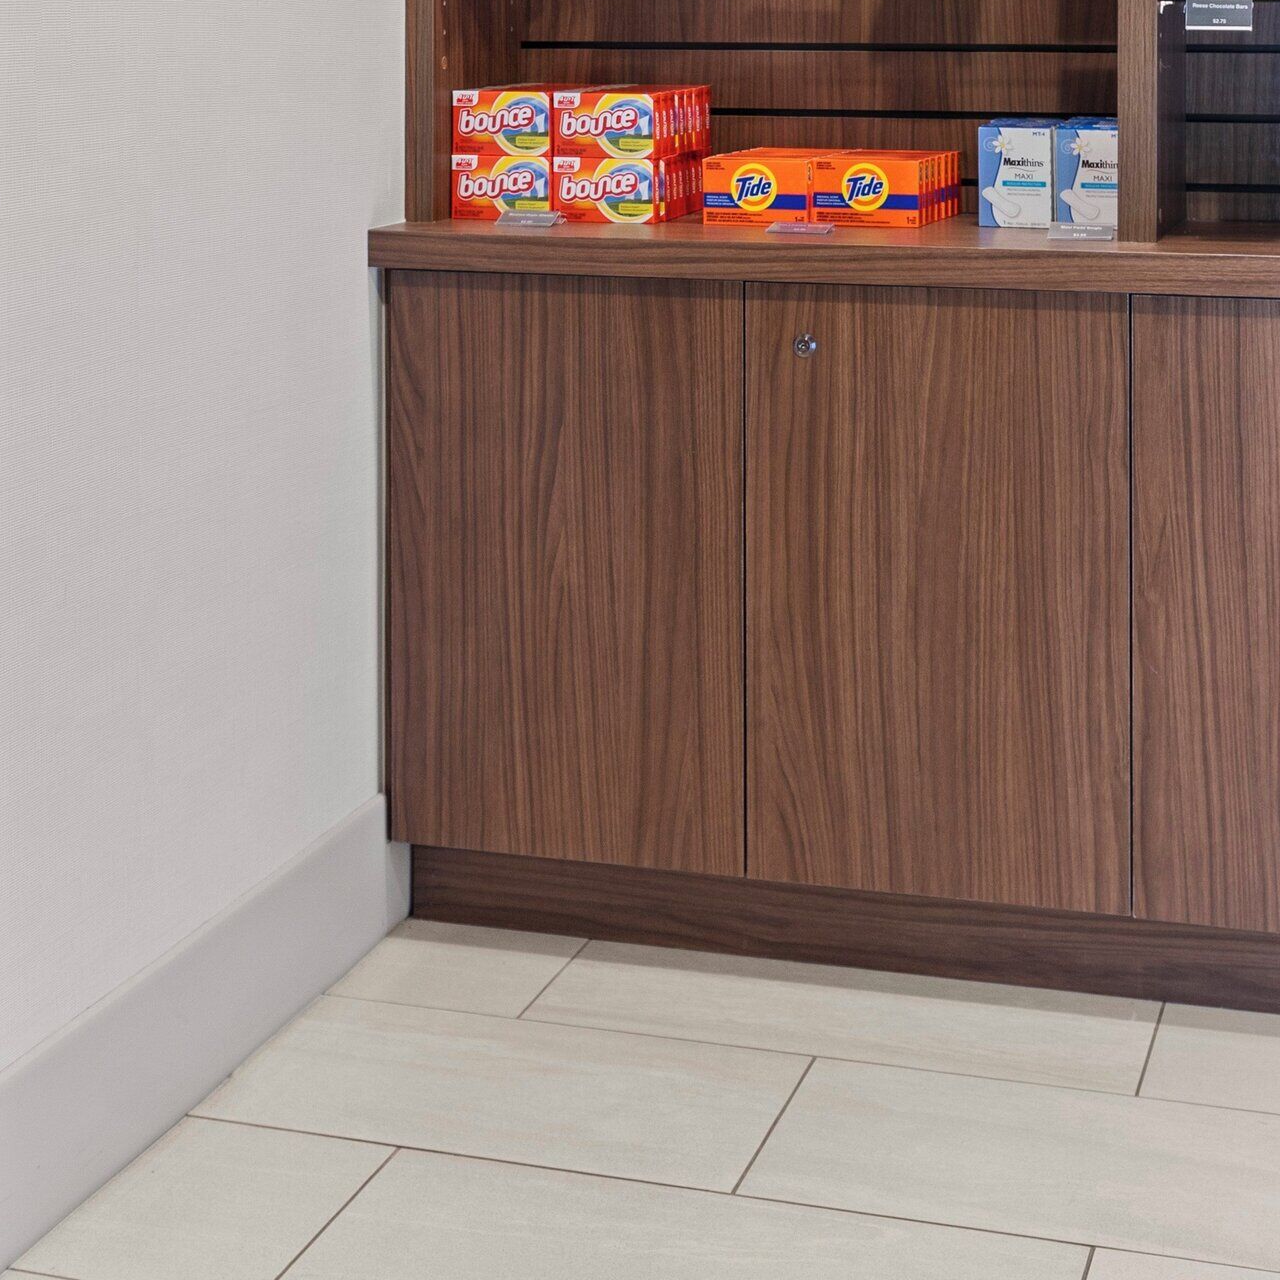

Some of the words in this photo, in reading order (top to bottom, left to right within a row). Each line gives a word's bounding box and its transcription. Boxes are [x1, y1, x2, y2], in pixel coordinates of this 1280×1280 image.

[459, 105, 536, 137] bounce
[560, 106, 639, 138] bounce
[1003, 156, 1045, 168] Maxithins
[458, 169, 536, 202] bounce
[559, 171, 638, 203] bounce
[733, 175, 774, 203] Tide
[845, 175, 884, 202] Tide
[1014, 173, 1035, 181] MAXI
[1093, 174, 1113, 182] MAXI
